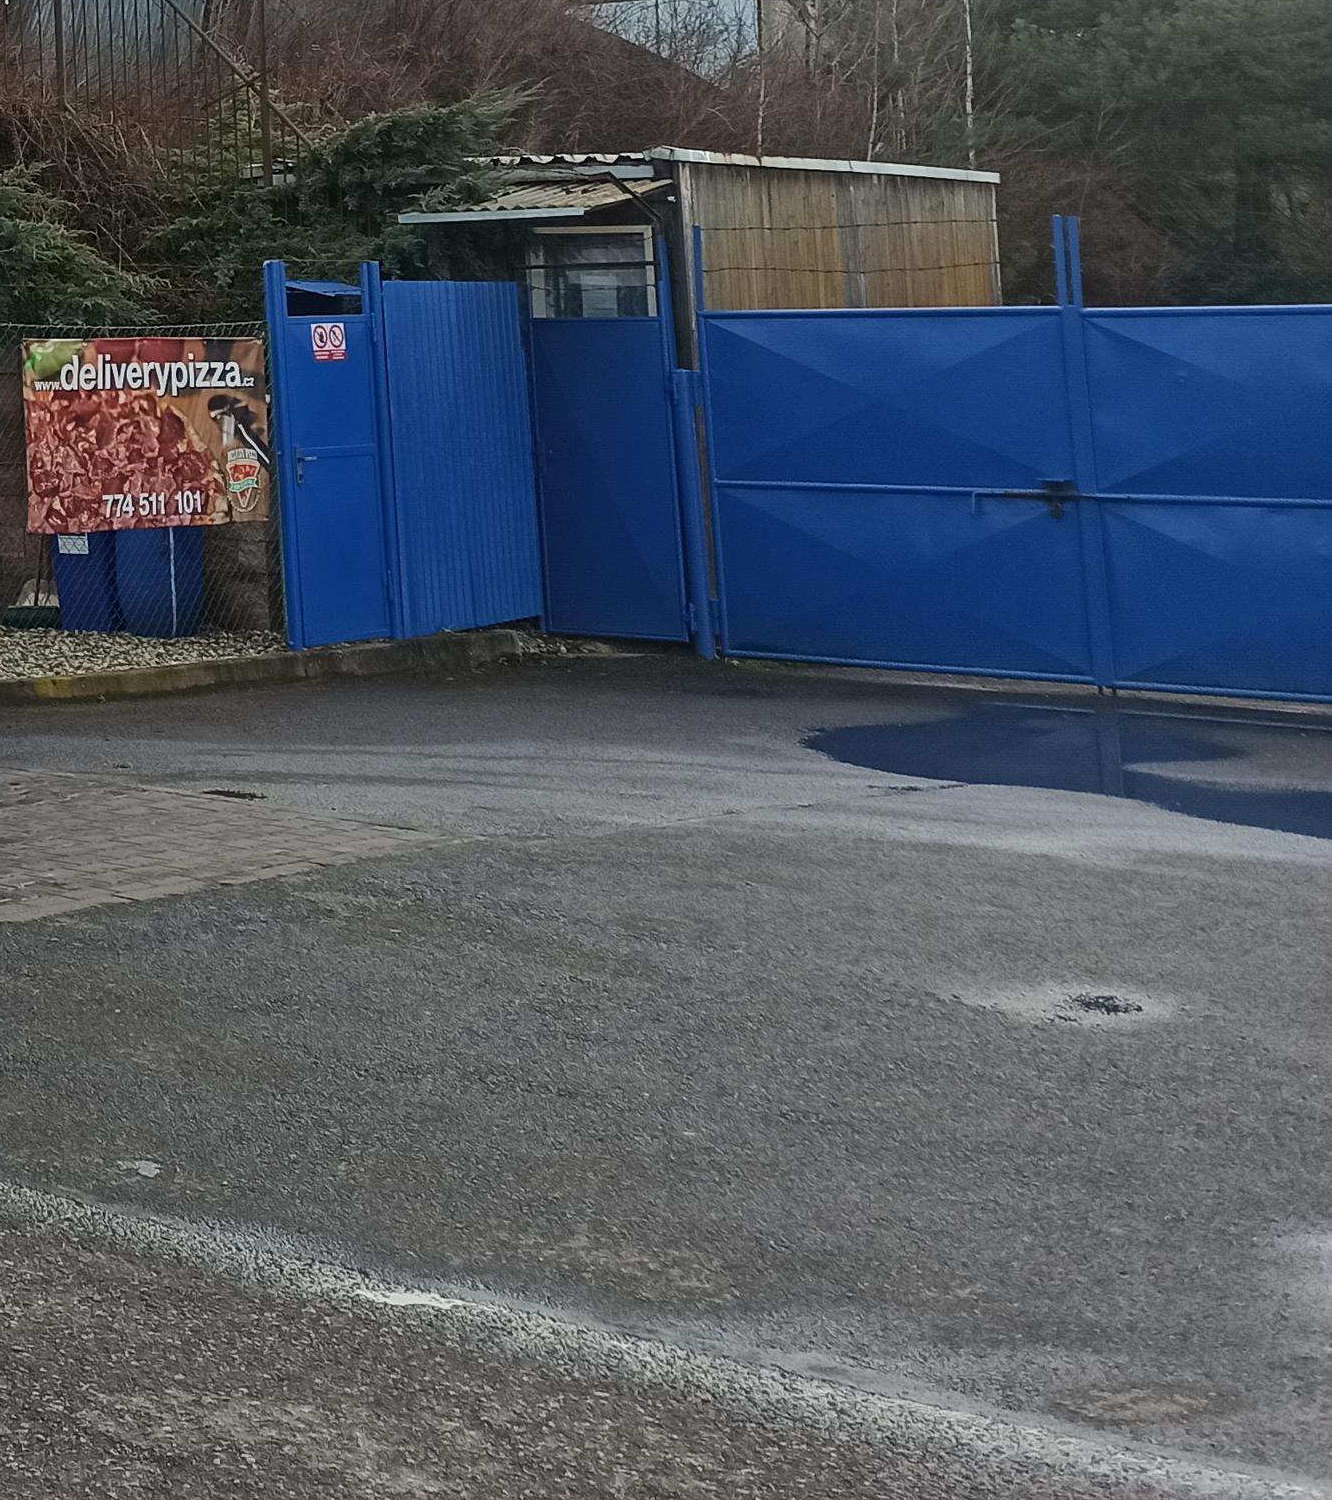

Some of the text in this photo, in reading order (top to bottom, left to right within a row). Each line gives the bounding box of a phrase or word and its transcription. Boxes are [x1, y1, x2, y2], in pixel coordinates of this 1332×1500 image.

[102, 490, 202, 518] 774 511 101
